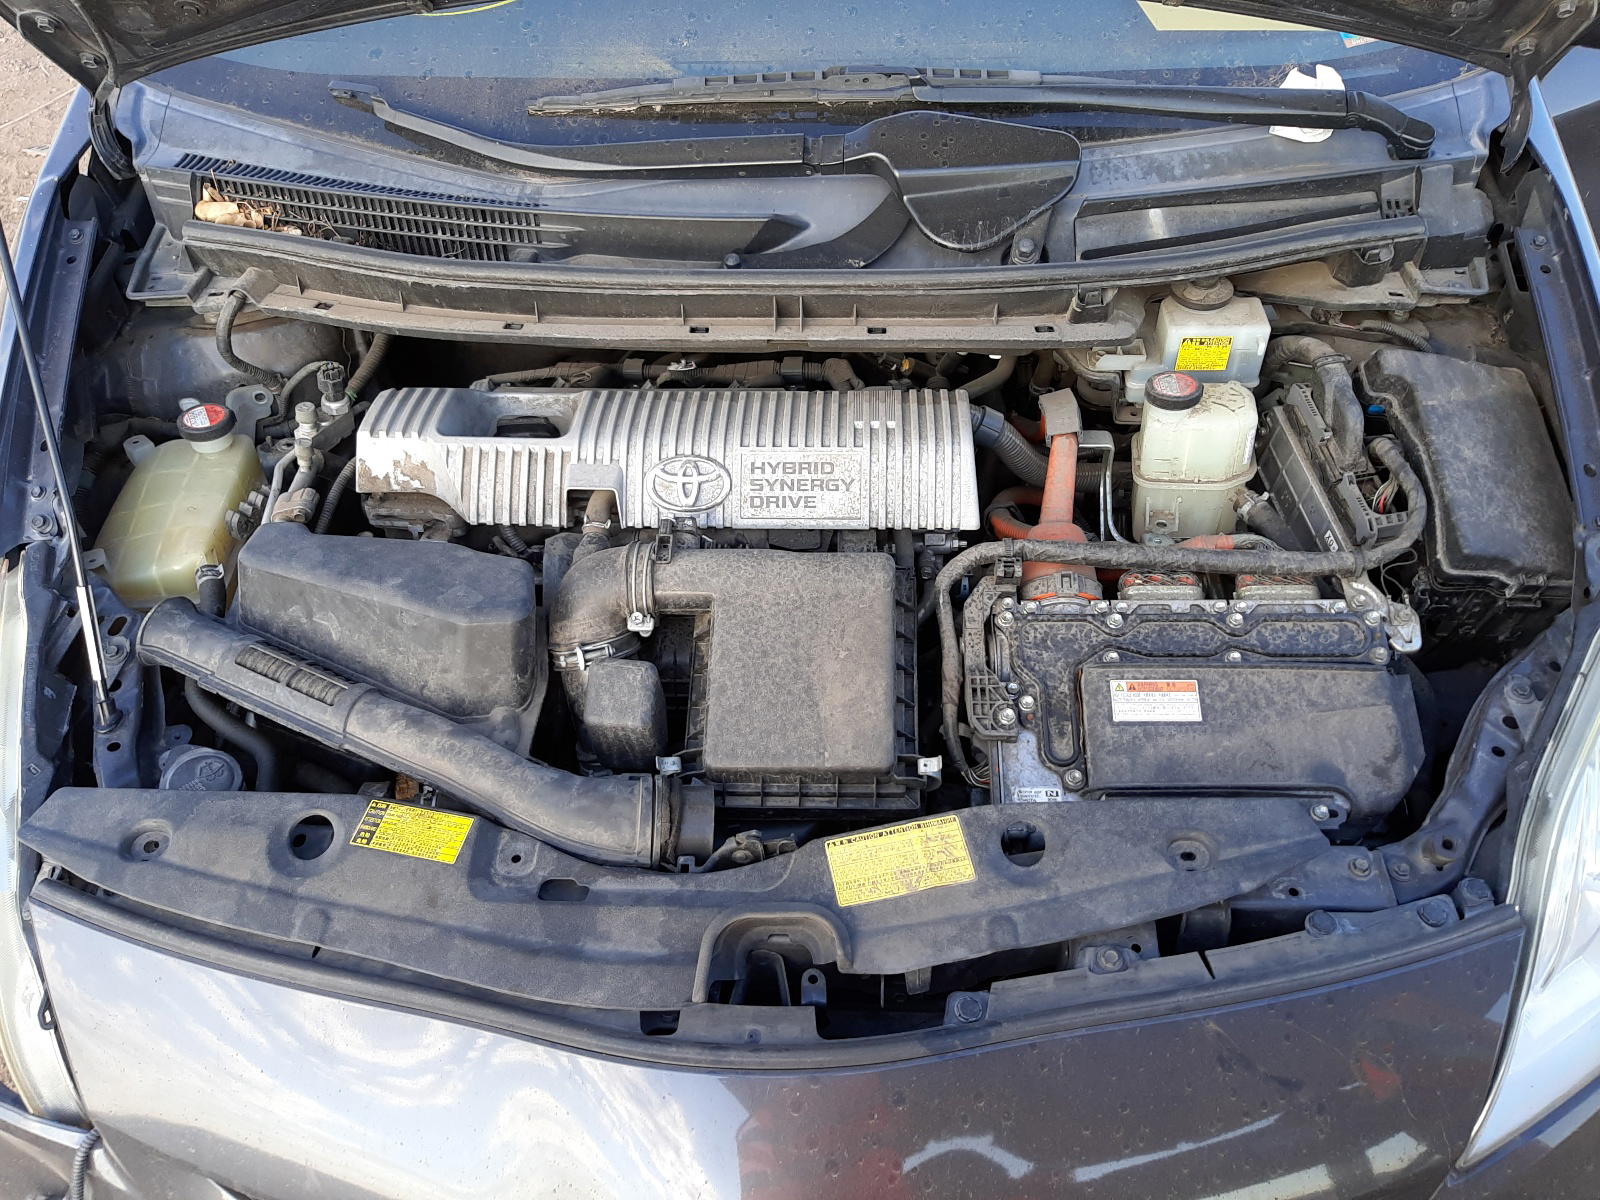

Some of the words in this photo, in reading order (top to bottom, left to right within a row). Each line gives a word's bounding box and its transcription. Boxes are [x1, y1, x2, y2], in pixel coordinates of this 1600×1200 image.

[751, 461, 835, 475] HYBRID
[750, 478, 855, 492] SYNERGY
[749, 496, 817, 509] DRIVE
